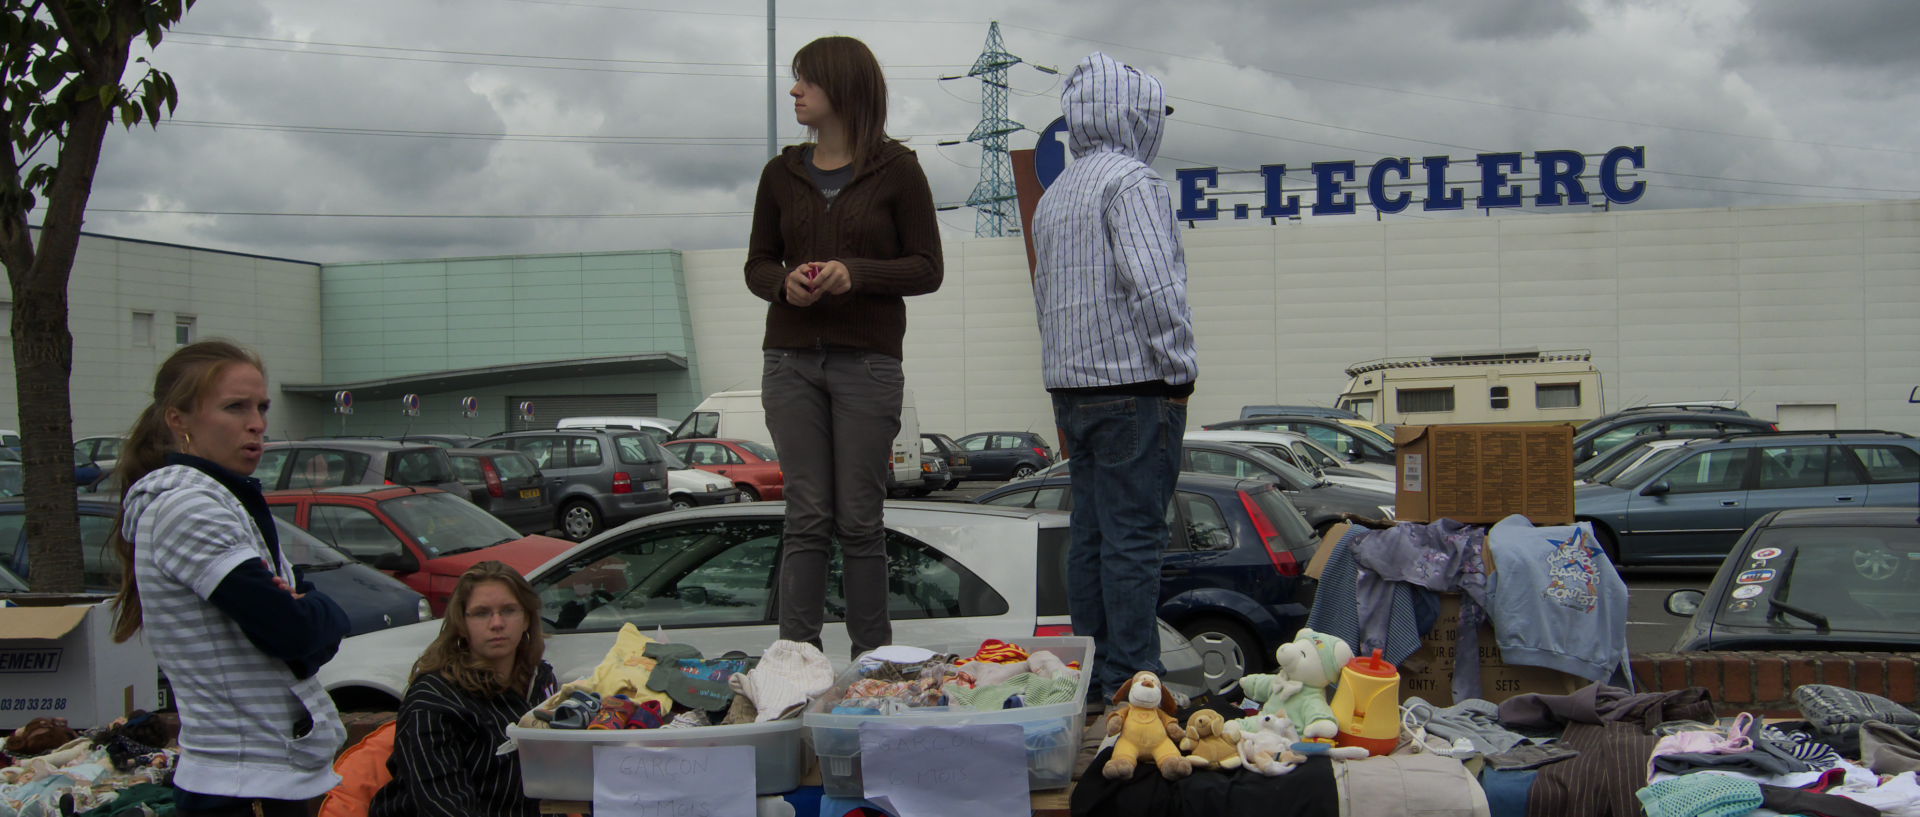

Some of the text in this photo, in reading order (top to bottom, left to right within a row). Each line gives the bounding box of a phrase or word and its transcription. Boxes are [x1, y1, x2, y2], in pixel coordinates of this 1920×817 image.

[1176, 145, 1647, 221] E.LECLERC
[1546, 587, 1598, 606] CONTEST
[1495, 679, 1521, 691] SETS
[1, 698, 67, 711] 03 20 33 23 88
